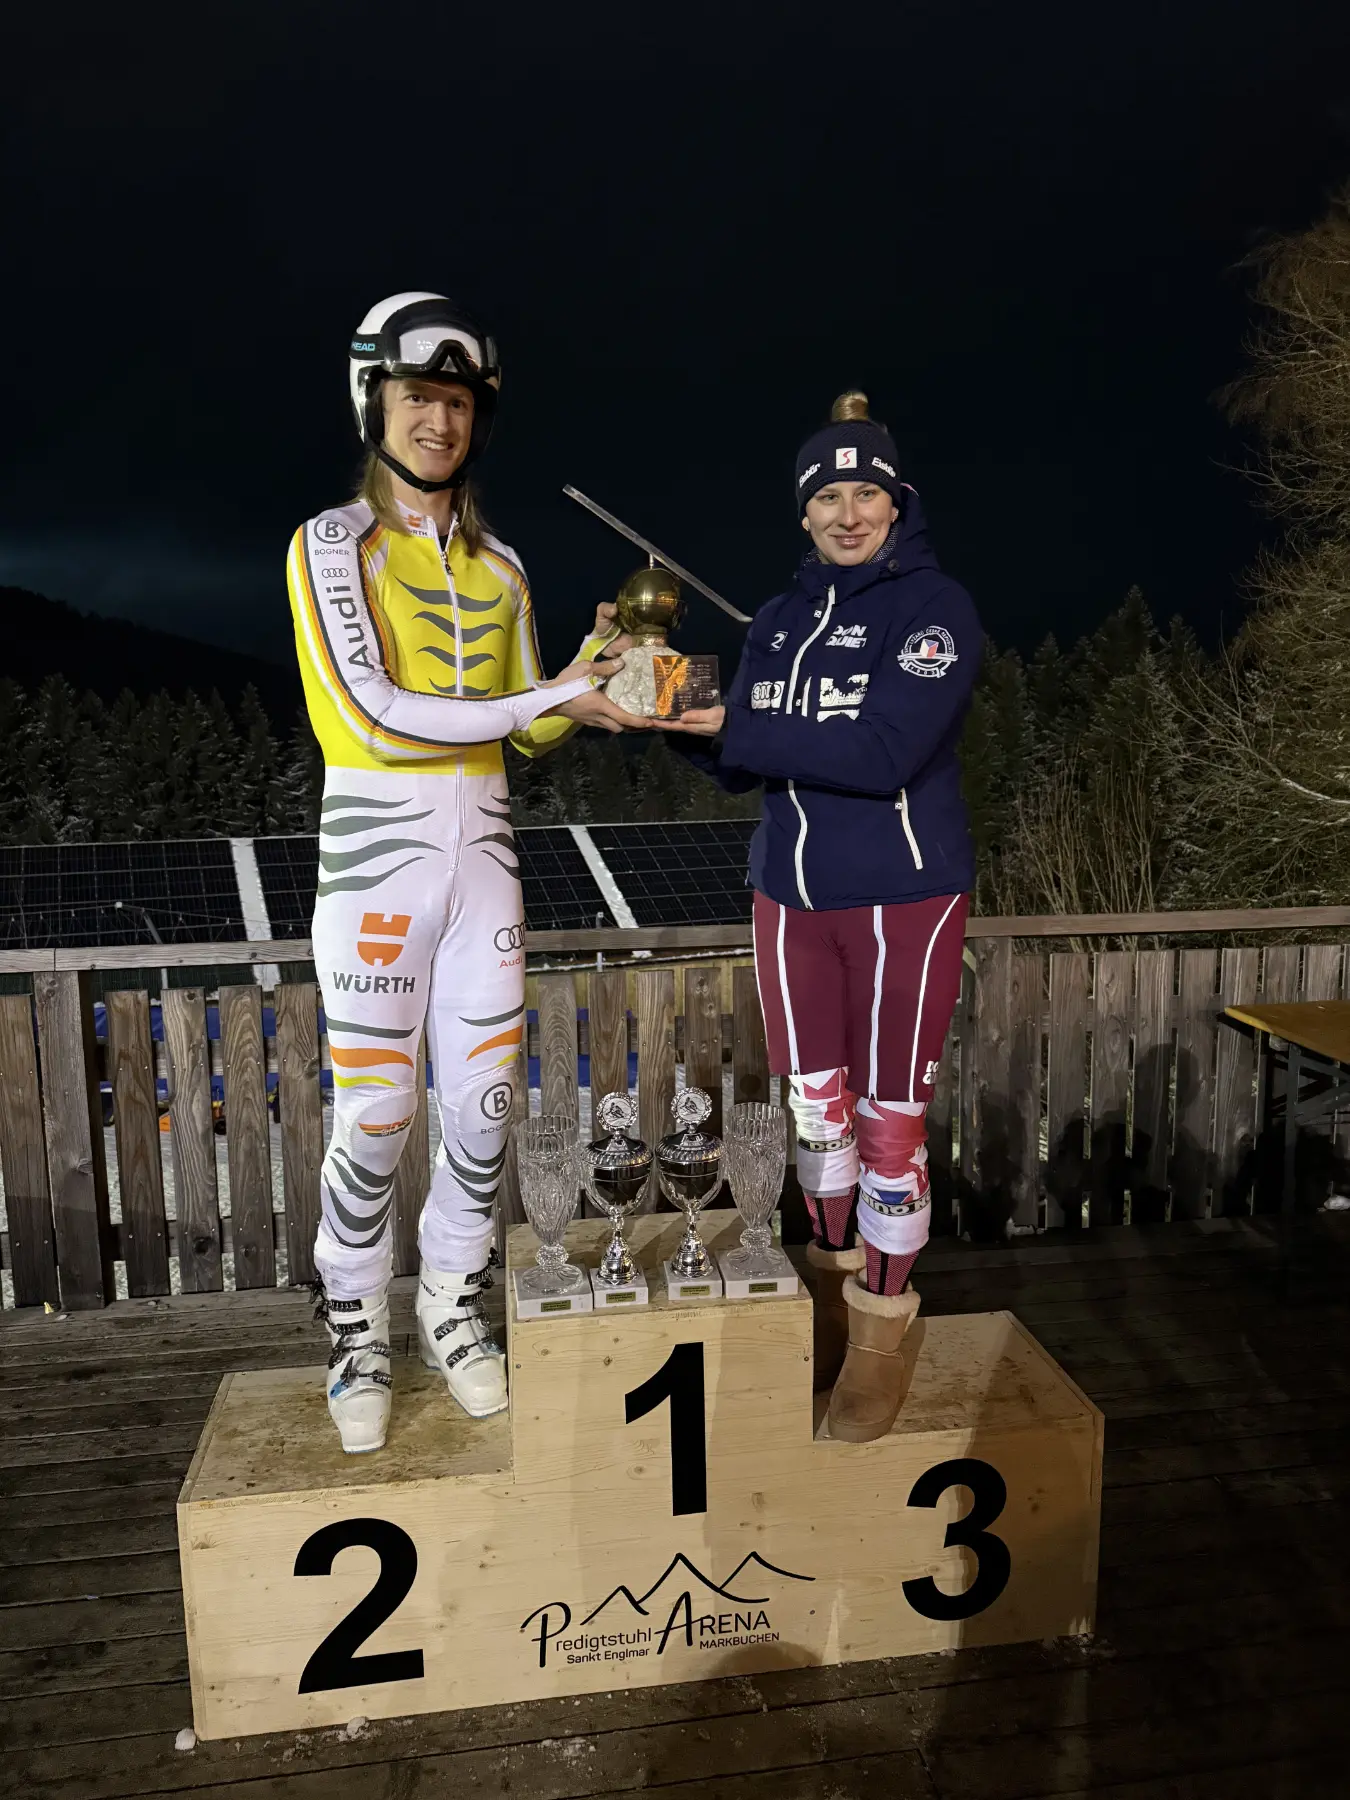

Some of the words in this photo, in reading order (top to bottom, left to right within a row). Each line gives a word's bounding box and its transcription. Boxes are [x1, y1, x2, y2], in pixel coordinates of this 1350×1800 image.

[314, 548, 350, 556] BOGNER
[326, 585, 375, 670] Audi
[333, 971, 415, 994] WÜRTH
[625, 1341, 708, 1517] 1
[901, 1458, 1011, 1621] 3
[293, 1517, 425, 1695] 2
[520, 1601, 652, 1668] Predigtstuhl
[654, 1591, 771, 1655] ARENA
[700, 1632, 780, 1650] MARKBUCHEN
[566, 1652, 602, 1665] Sankt
[604, 1648, 650, 1662] Englmar
